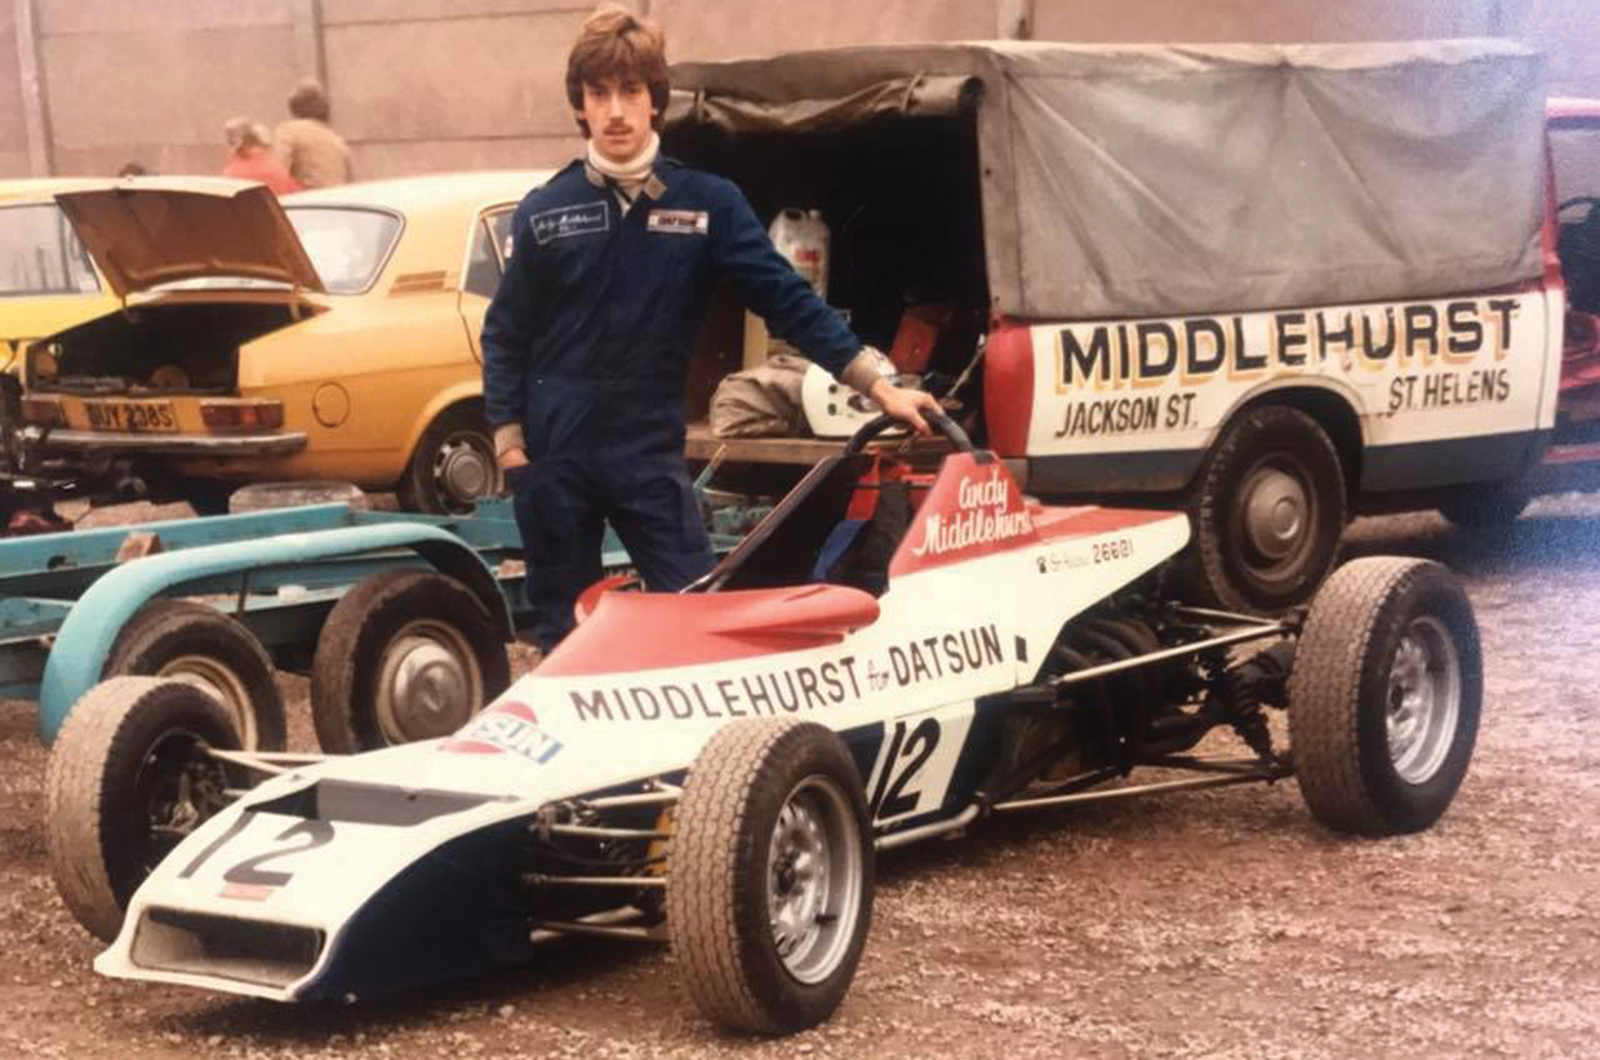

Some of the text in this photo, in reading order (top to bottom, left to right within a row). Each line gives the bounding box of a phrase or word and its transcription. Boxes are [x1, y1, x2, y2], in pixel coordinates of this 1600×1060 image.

[1056, 300, 1520, 390] MIDDLEHURST
[1055, 392, 1200, 438] JACKSON ST.
[1423, 369, 1511, 408] HELENS
[958, 469, 1008, 512] Andy
[568, 656, 861, 721] MIDDLEHURST
[888, 624, 1004, 686] DATSUN
[868, 716, 942, 822] 12
[176, 807, 335, 888] 12
